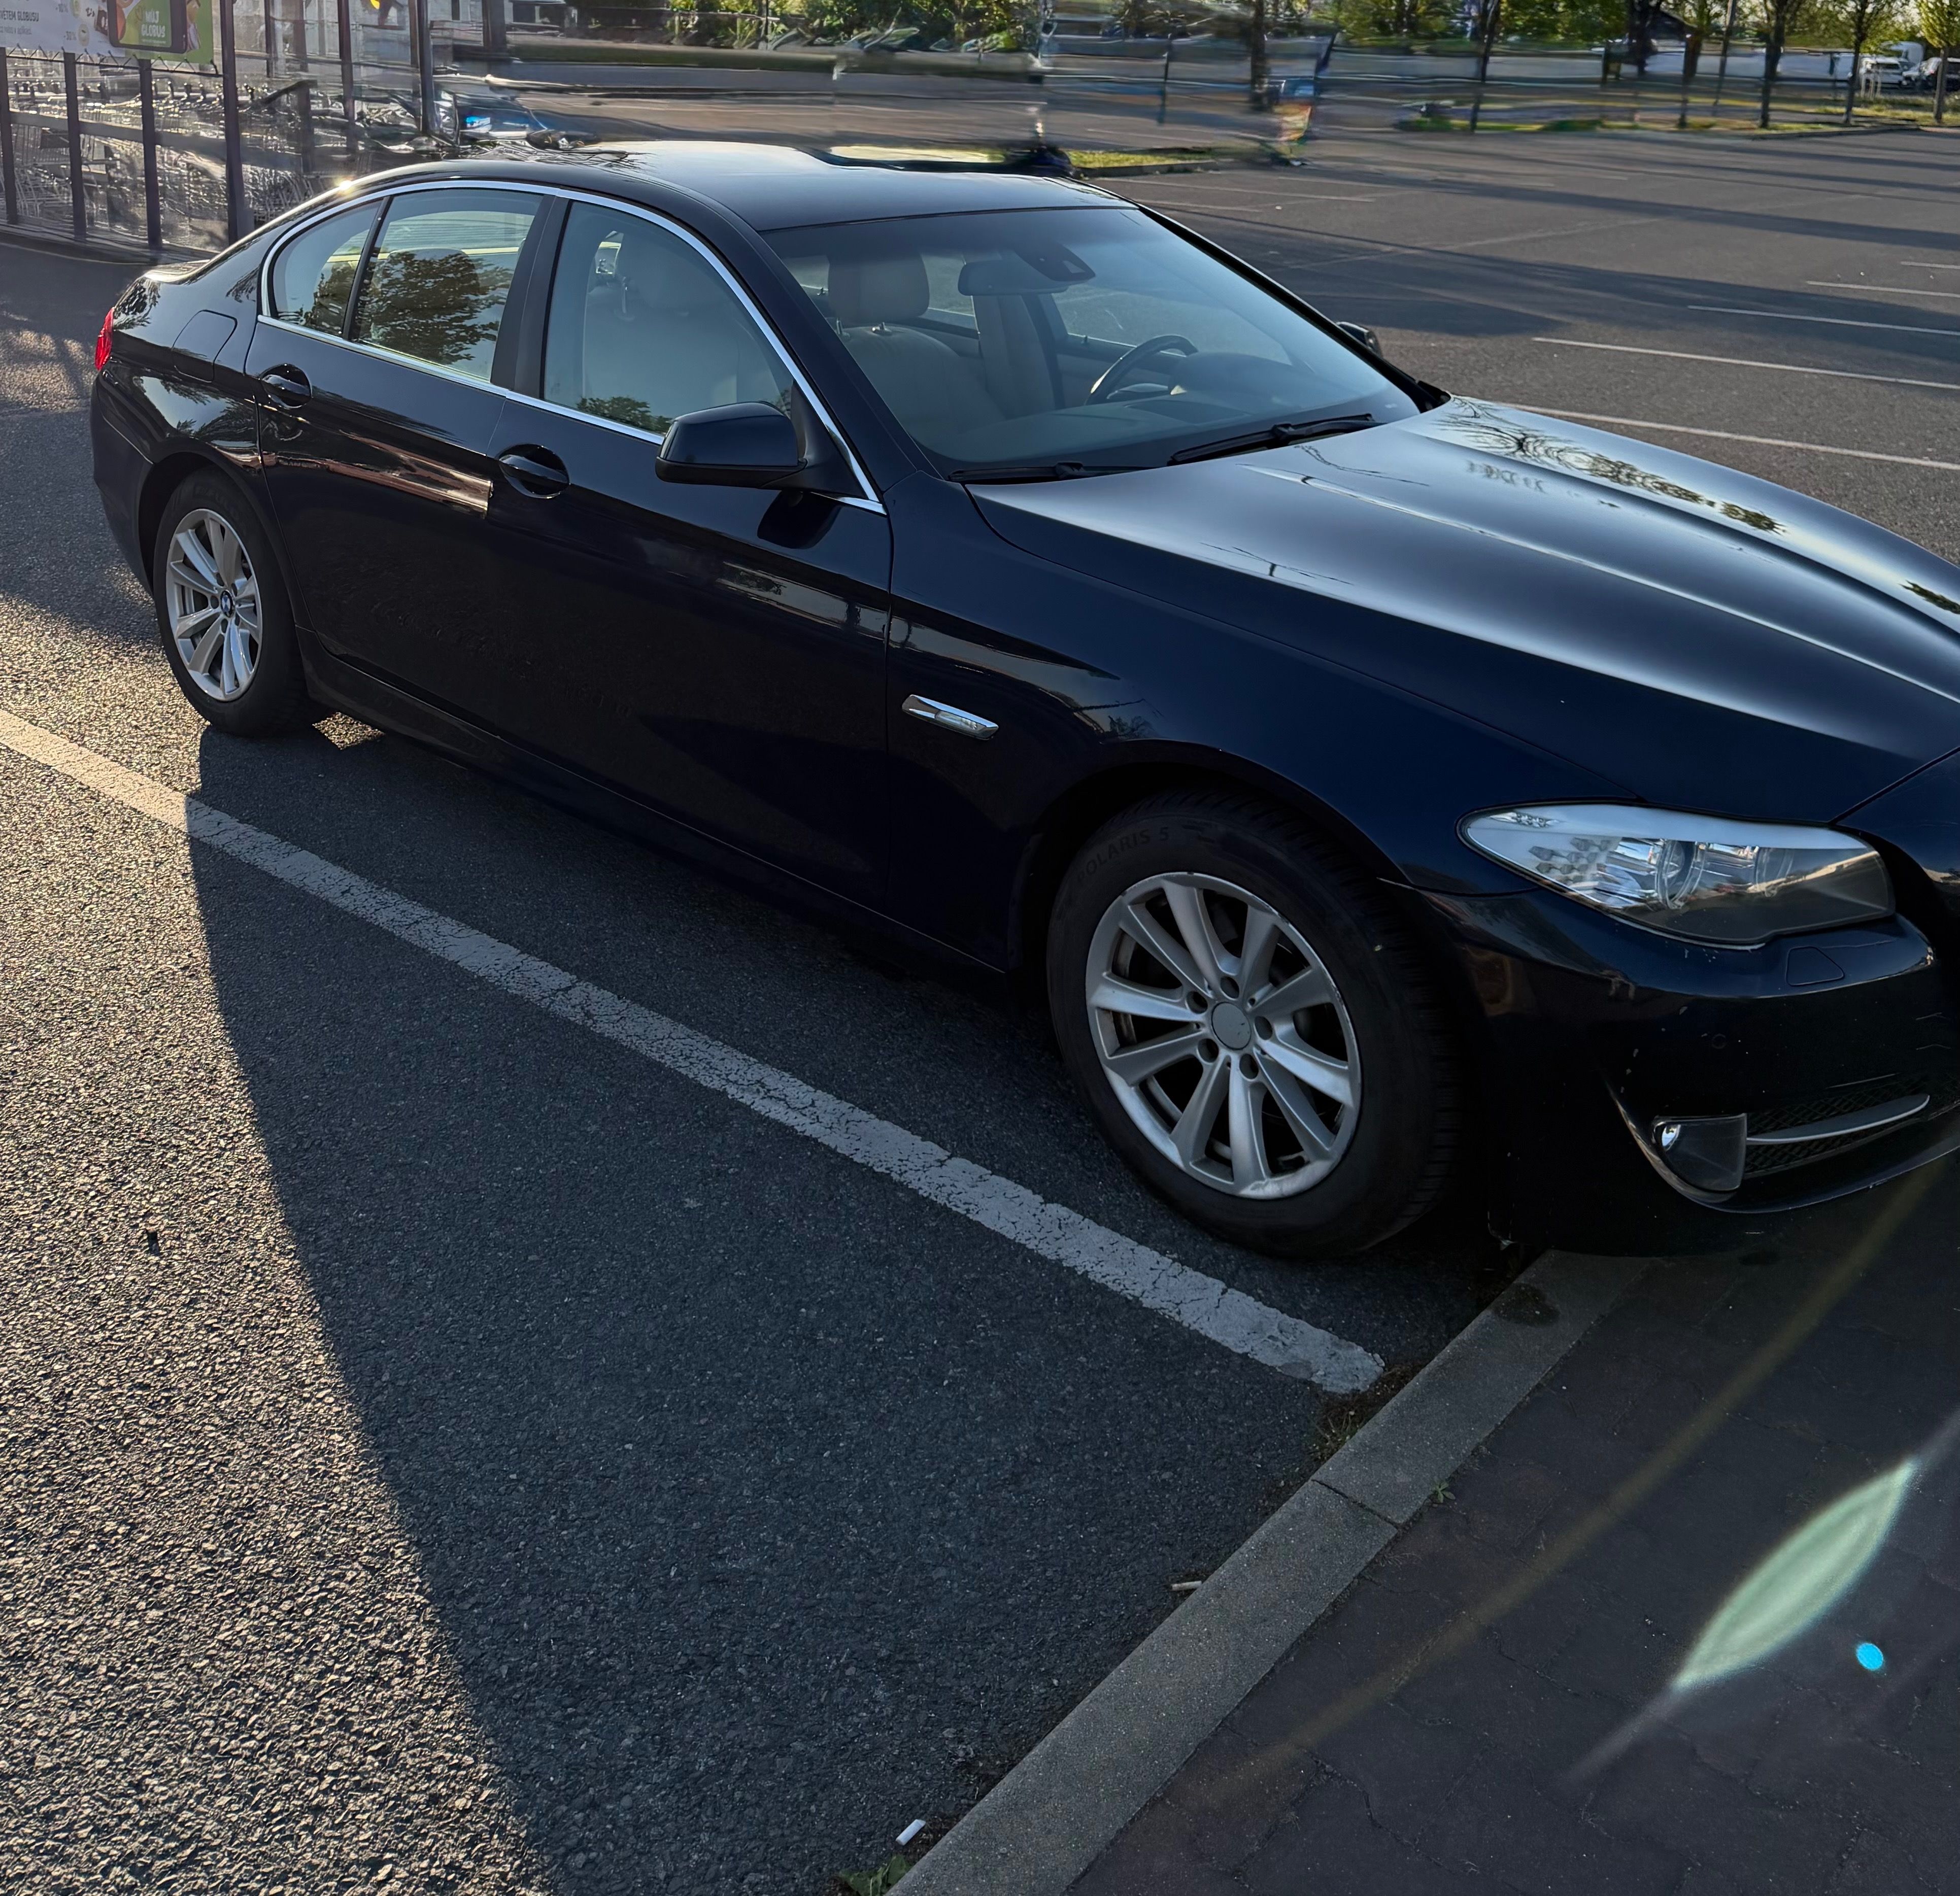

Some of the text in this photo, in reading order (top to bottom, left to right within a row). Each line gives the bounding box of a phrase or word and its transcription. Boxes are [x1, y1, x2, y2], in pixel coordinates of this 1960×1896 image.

[141, 24, 165, 38] GLOBUS
[1077, 827, 1169, 882] POLARIS 5
